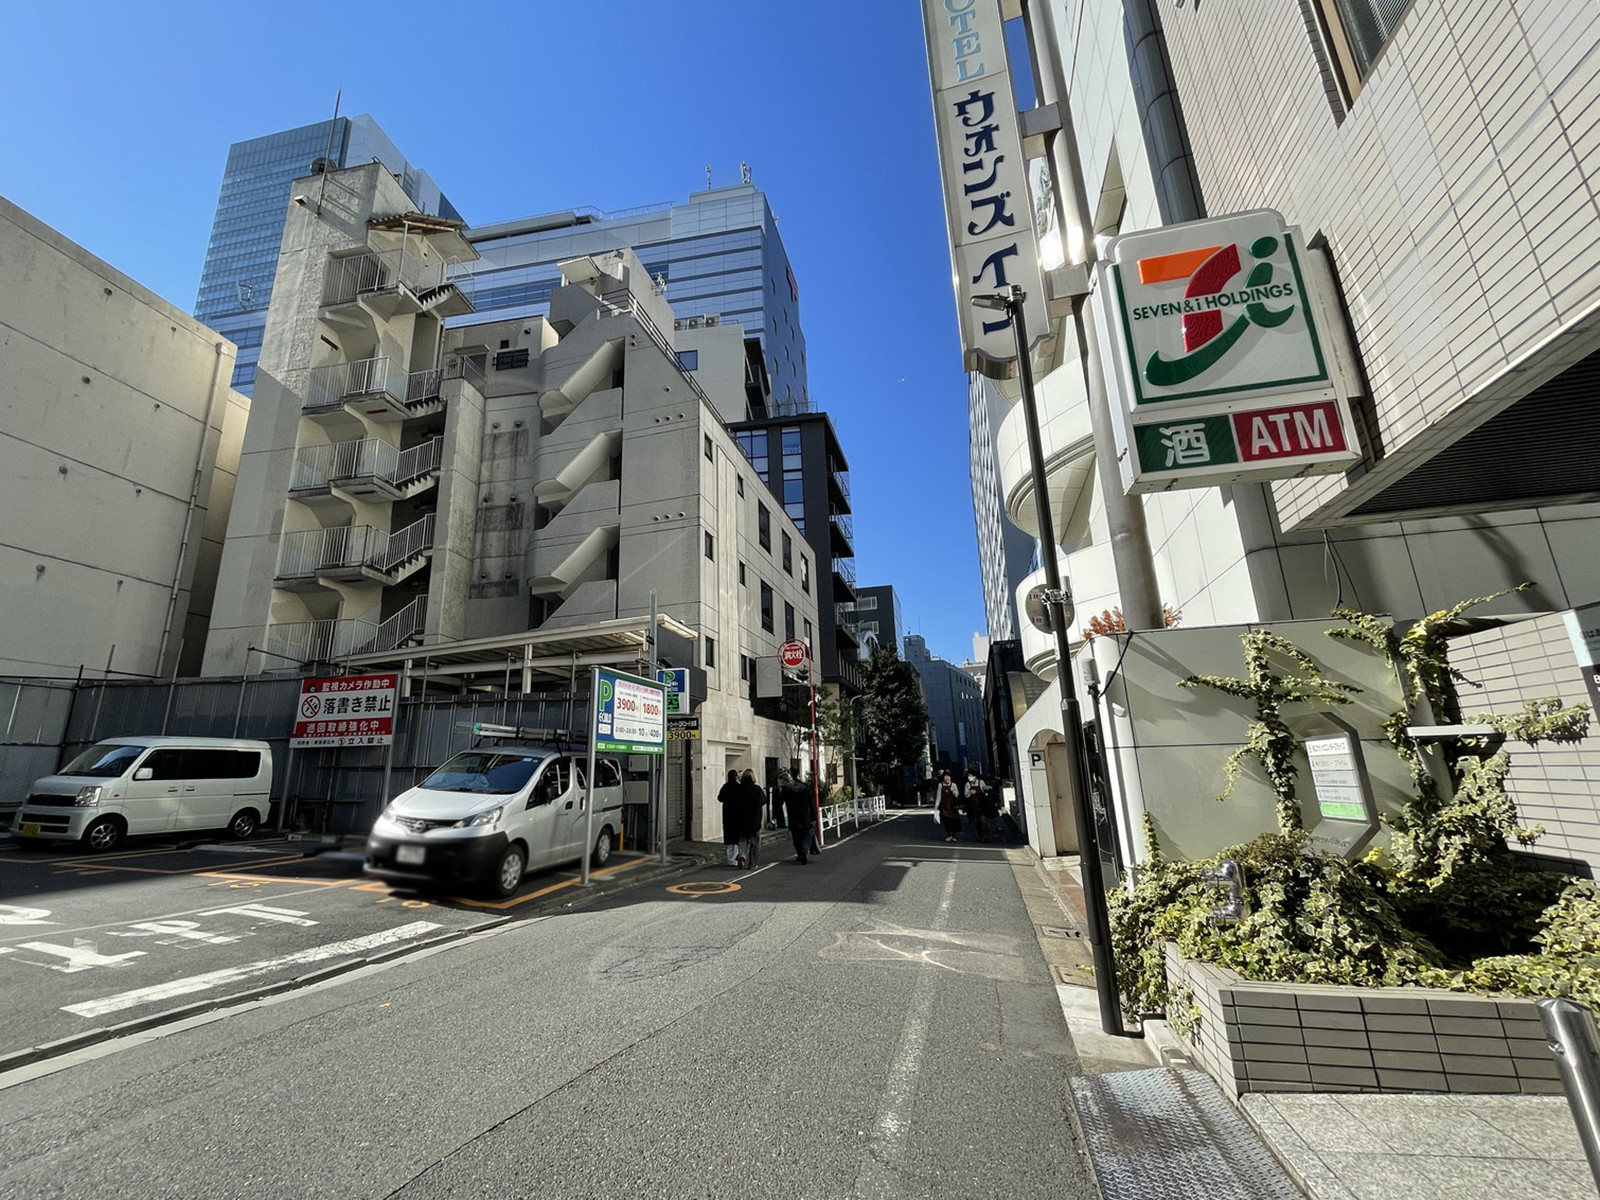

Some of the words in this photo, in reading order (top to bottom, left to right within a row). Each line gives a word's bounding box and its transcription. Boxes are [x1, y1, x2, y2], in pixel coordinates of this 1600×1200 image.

[1133, 299, 1201, 321] SEVEN&i
[1206, 283, 1293, 309] HOLDINGS
[1159, 423, 1210, 467] 酒
[1251, 409, 1333, 455] ATM
[322, 678, 390, 692] 監視カメラ作動中
[599, 679, 613, 712] P
[323, 694, 391, 715] 落書き禁止
[1031, 753, 1042, 767] P
